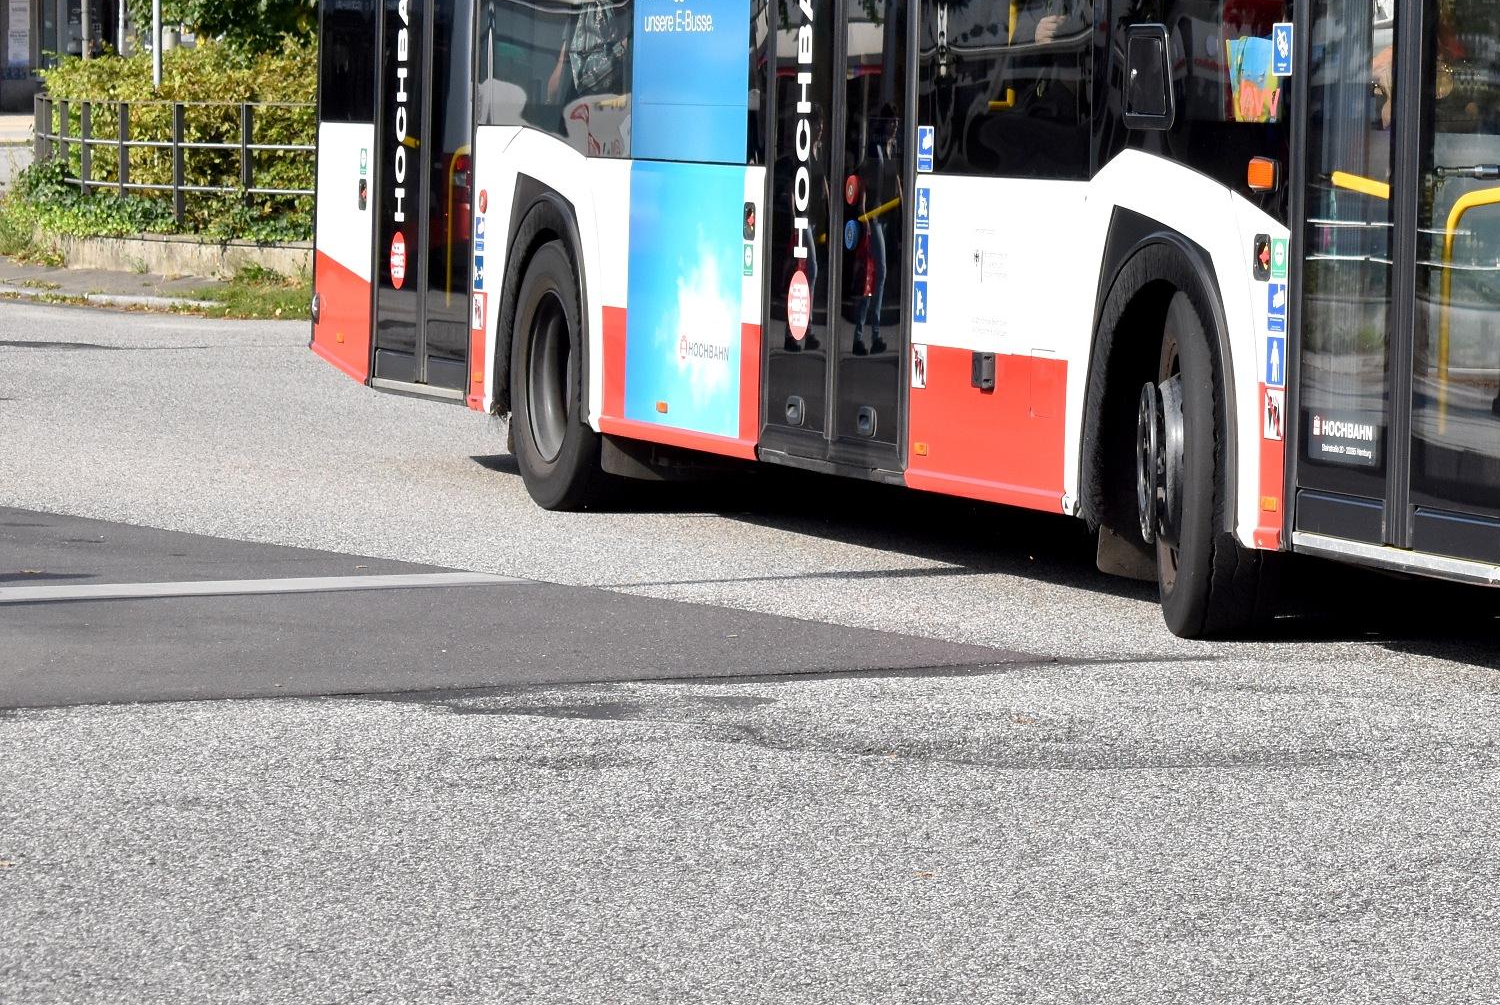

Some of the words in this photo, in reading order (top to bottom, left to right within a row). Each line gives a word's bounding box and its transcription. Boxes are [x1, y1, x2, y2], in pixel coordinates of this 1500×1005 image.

[644, 14, 674, 33] unsere
[675, 10, 715, 32] E-Busse.
[688, 341, 730, 362] HOCHBAHN
[1322, 420, 1373, 442] HOCHBAHN
